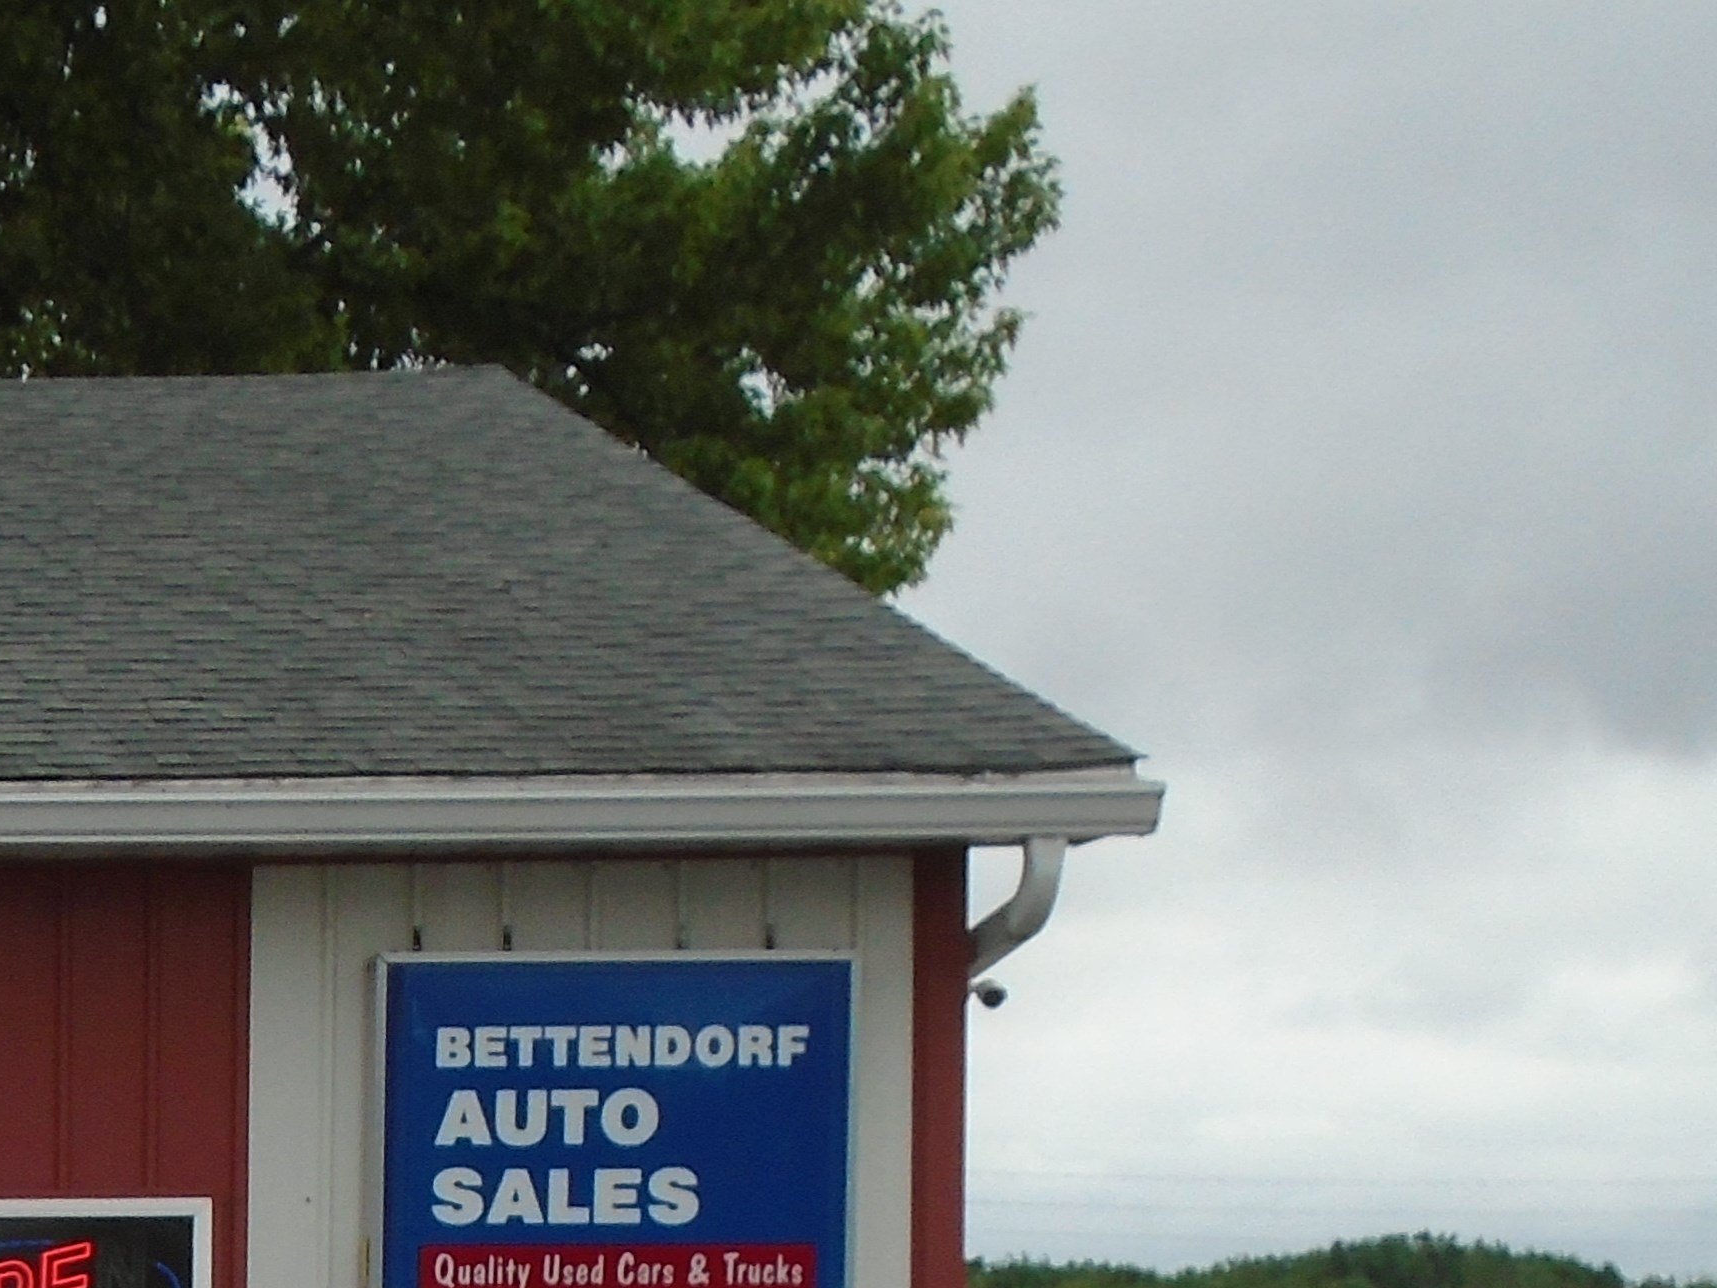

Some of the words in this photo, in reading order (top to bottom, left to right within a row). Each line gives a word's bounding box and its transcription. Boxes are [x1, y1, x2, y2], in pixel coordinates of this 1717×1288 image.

[435, 1025, 809, 1067] BETTENDORF
[434, 1088, 660, 1146] AUTO
[431, 1167, 700, 1225] SALES
[543, 1254, 605, 1286] Used
[616, 1252, 674, 1286] Cars
[687, 1253, 710, 1285] &
[723, 1252, 803, 1285] Trucks
